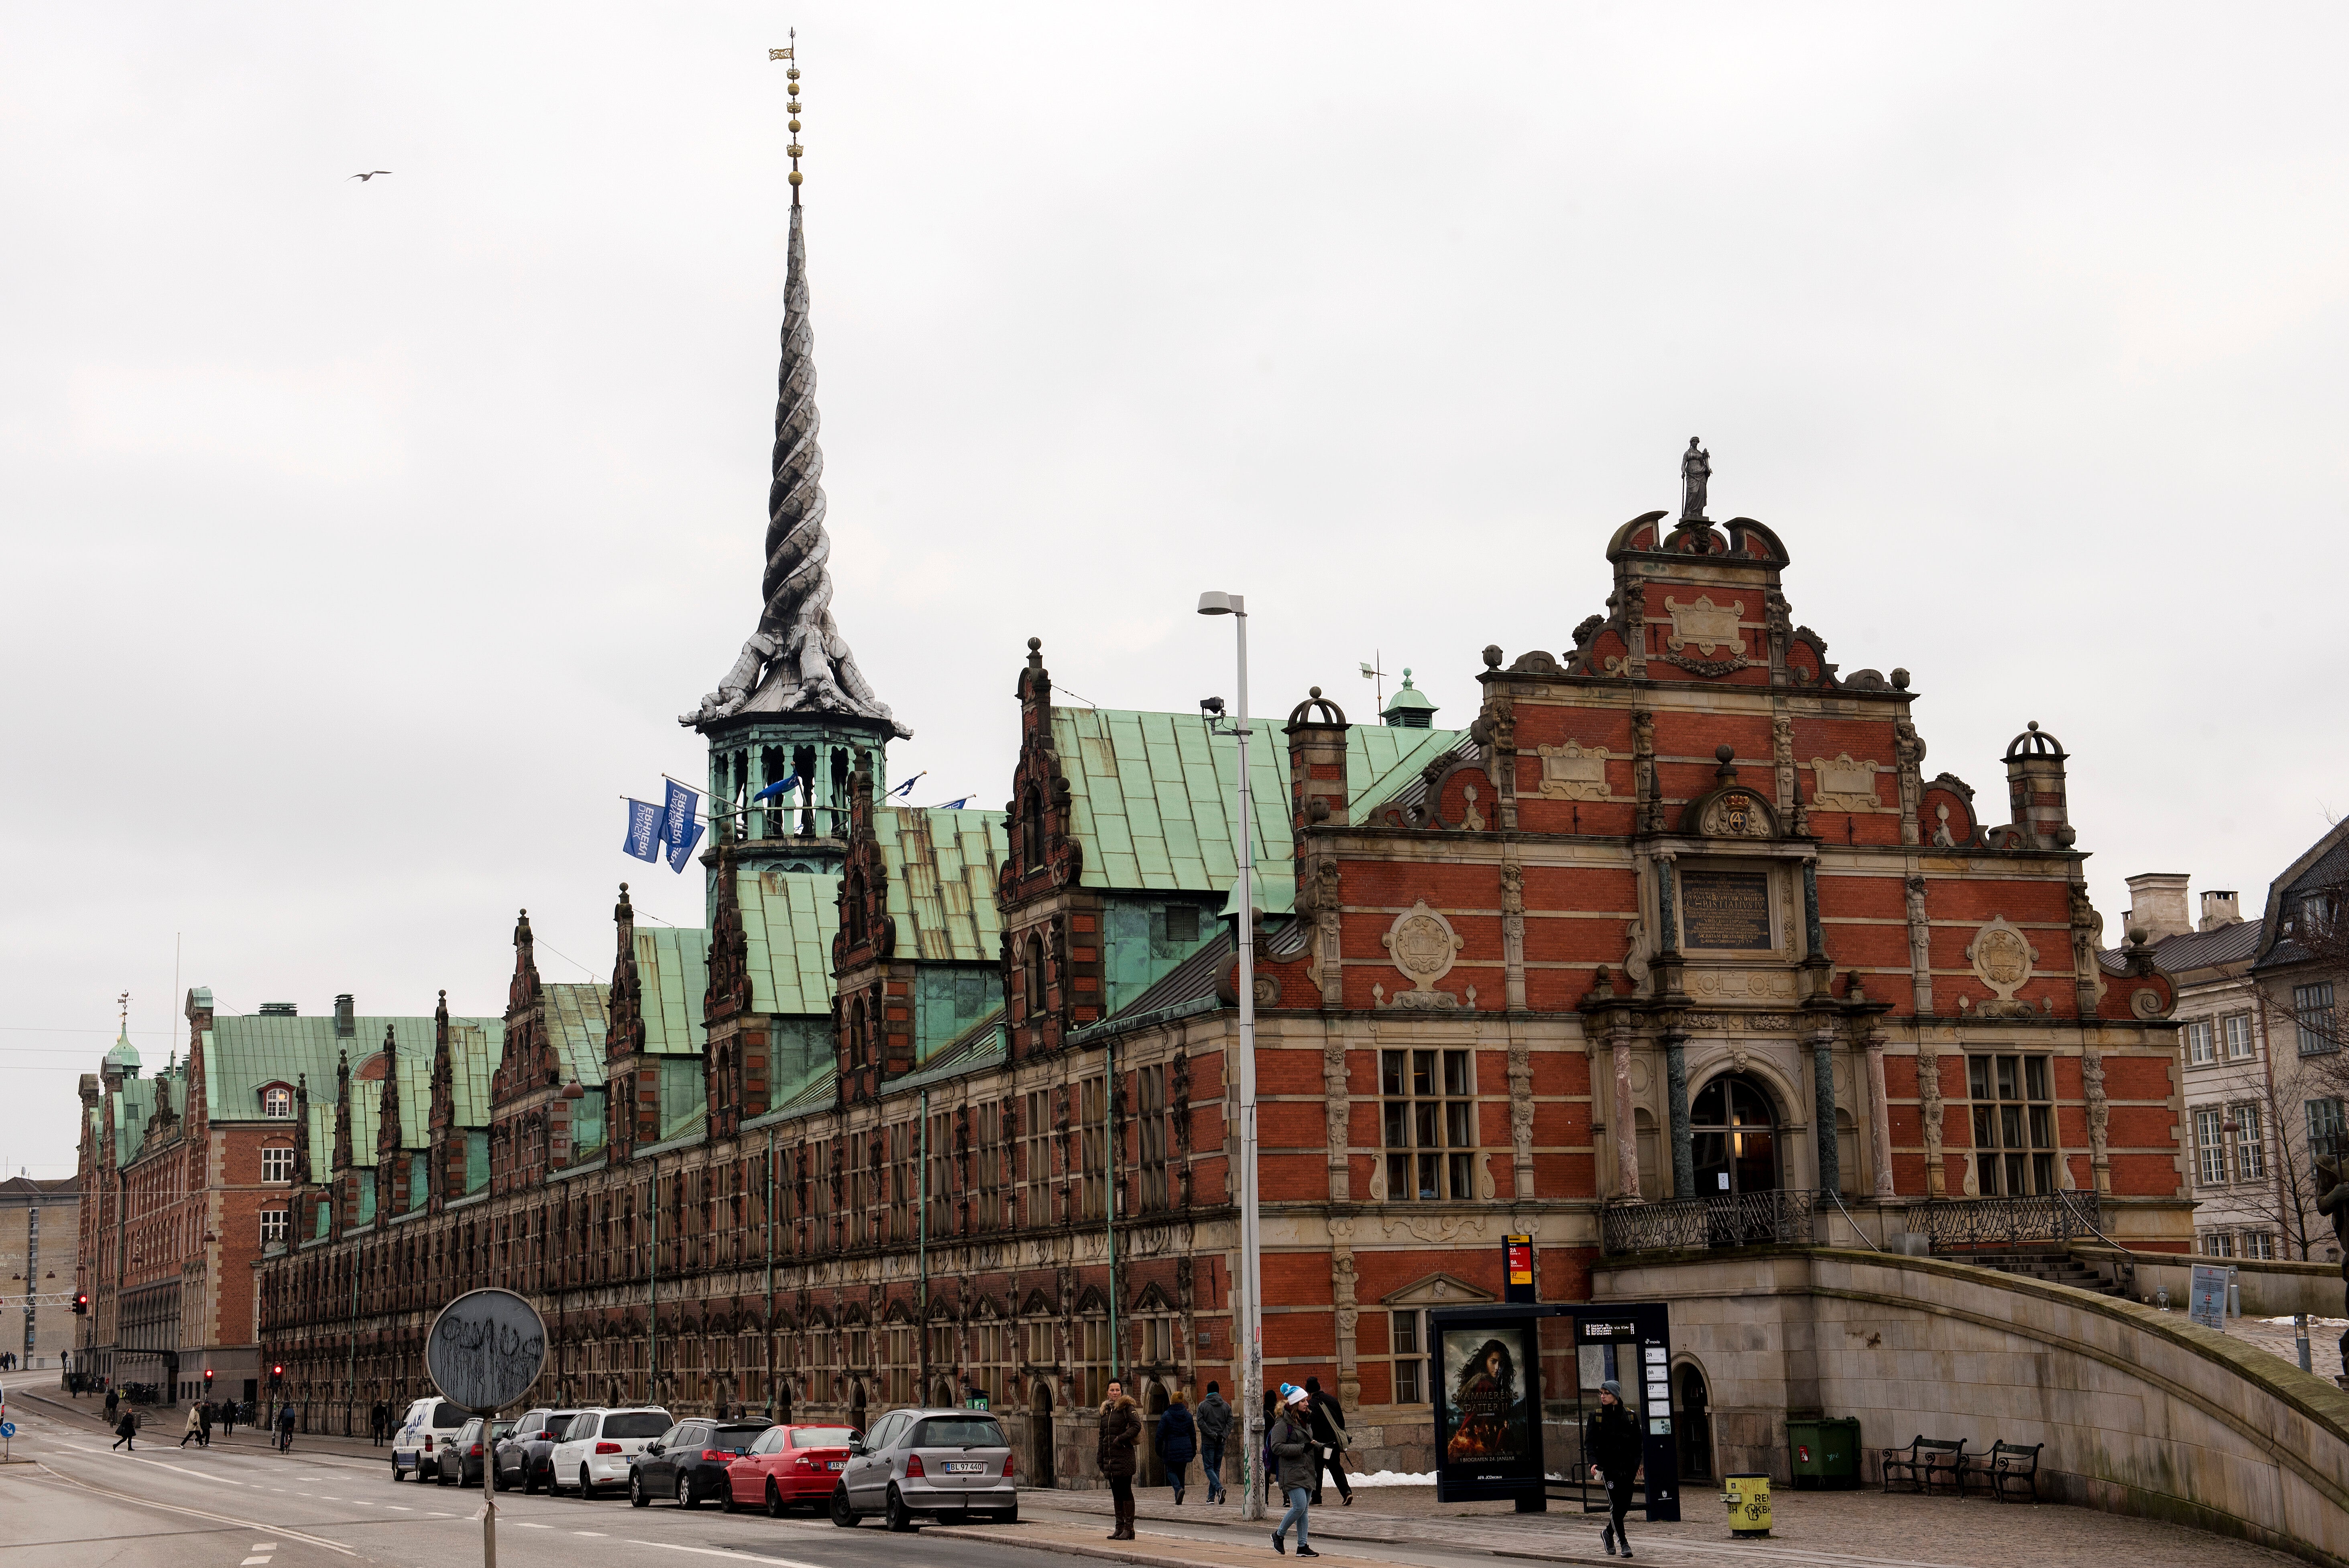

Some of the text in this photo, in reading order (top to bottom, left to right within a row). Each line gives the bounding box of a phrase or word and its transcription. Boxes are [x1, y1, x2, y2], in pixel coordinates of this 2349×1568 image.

[1755, 901, 1764, 909] IV
[1451, 1391, 1519, 1403] SKAMMERENS
[1464, 1403, 1499, 1411] DATTER
[1755, 1494, 1770, 1502] REN
[1756, 1505, 1771, 1514] KBH
